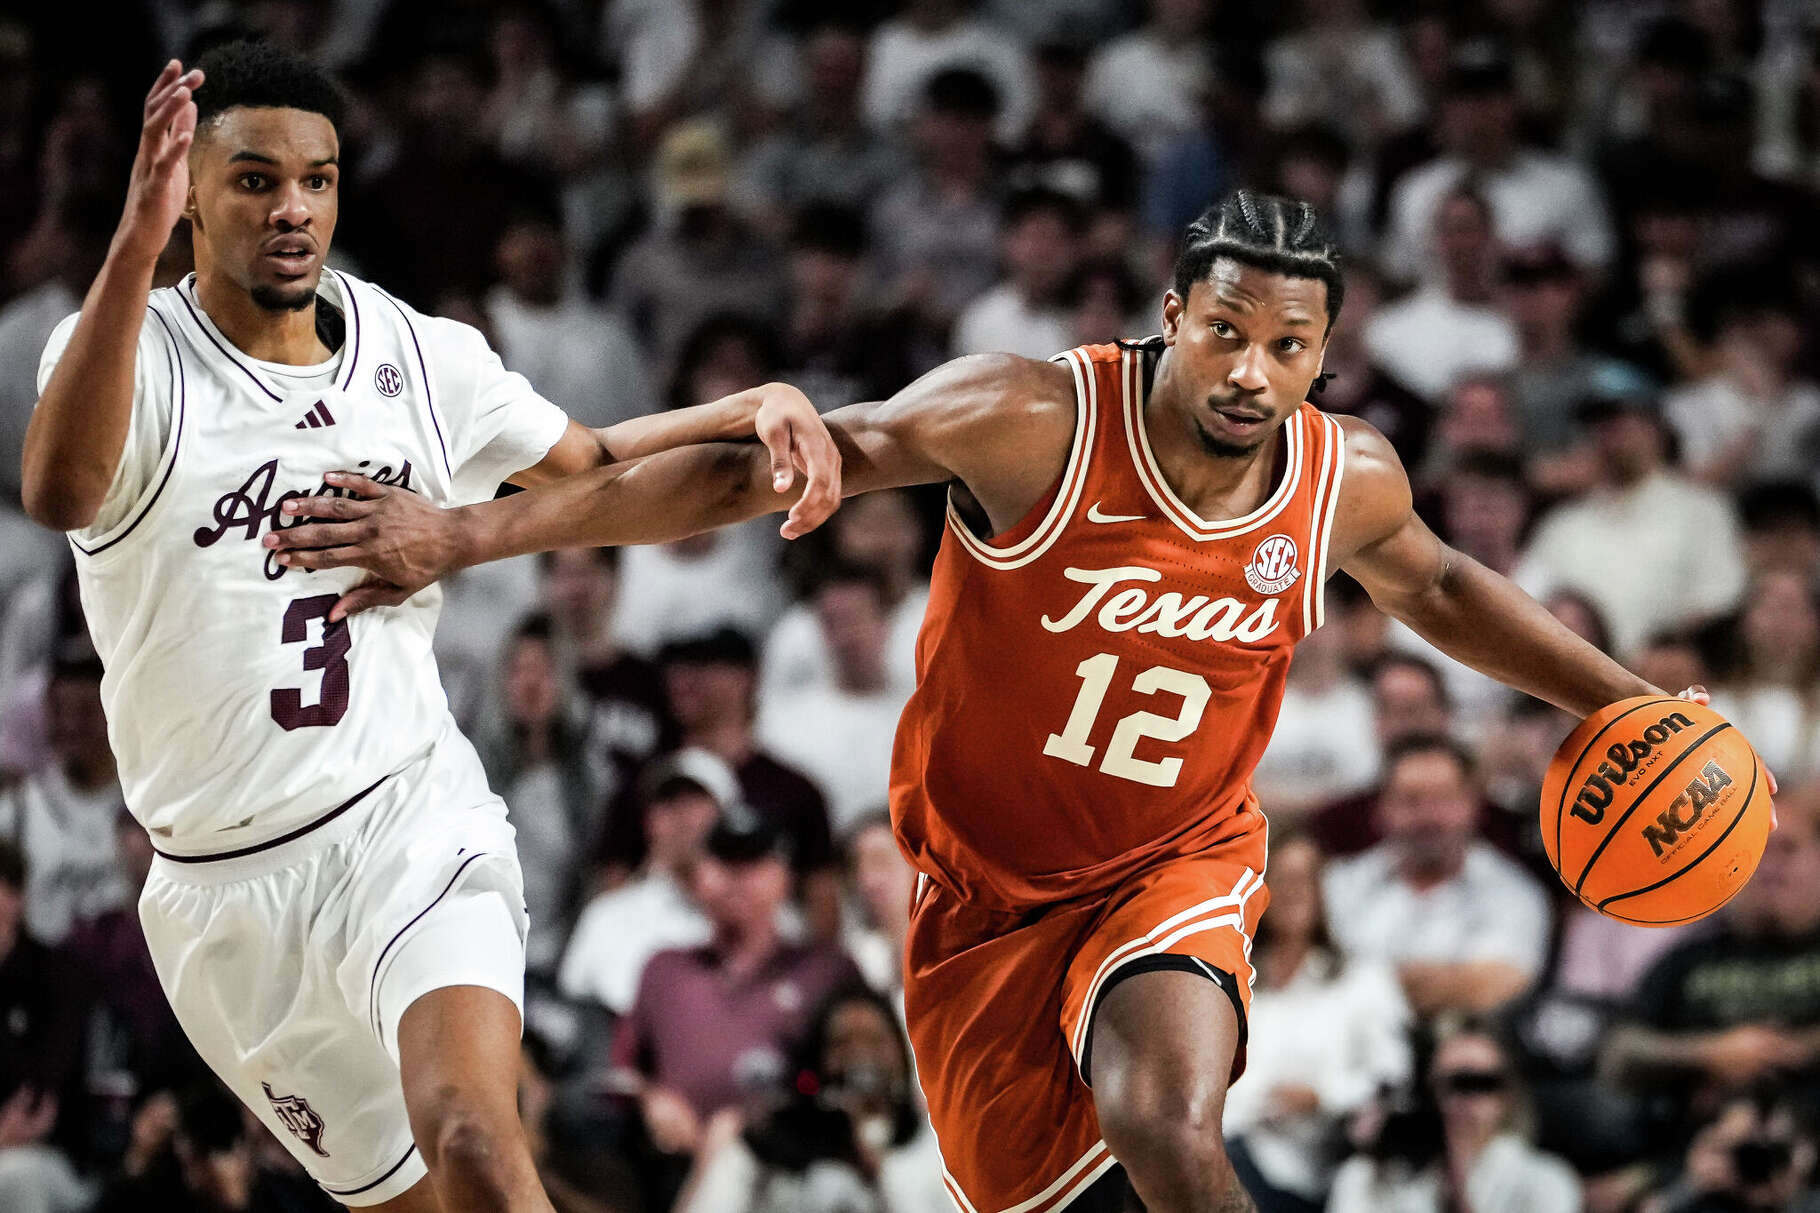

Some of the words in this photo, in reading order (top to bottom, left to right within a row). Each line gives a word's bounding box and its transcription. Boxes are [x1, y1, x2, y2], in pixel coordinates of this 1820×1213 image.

[378, 367, 400, 394] SEC
[1247, 573, 1291, 594] GRADUATE
[1256, 537, 1295, 580] SEC
[1040, 566, 1280, 643] Texas
[270, 593, 352, 732] 3
[1042, 652, 1213, 788] 12
[1569, 712, 1696, 826] Wilson
[1628, 768, 1647, 787] EVO
[1646, 750, 1663, 768] NXT
[1641, 759, 1734, 858] NCAA
[1660, 832, 1696, 865] OFFICIAL
[1697, 806, 1721, 831] GAME
